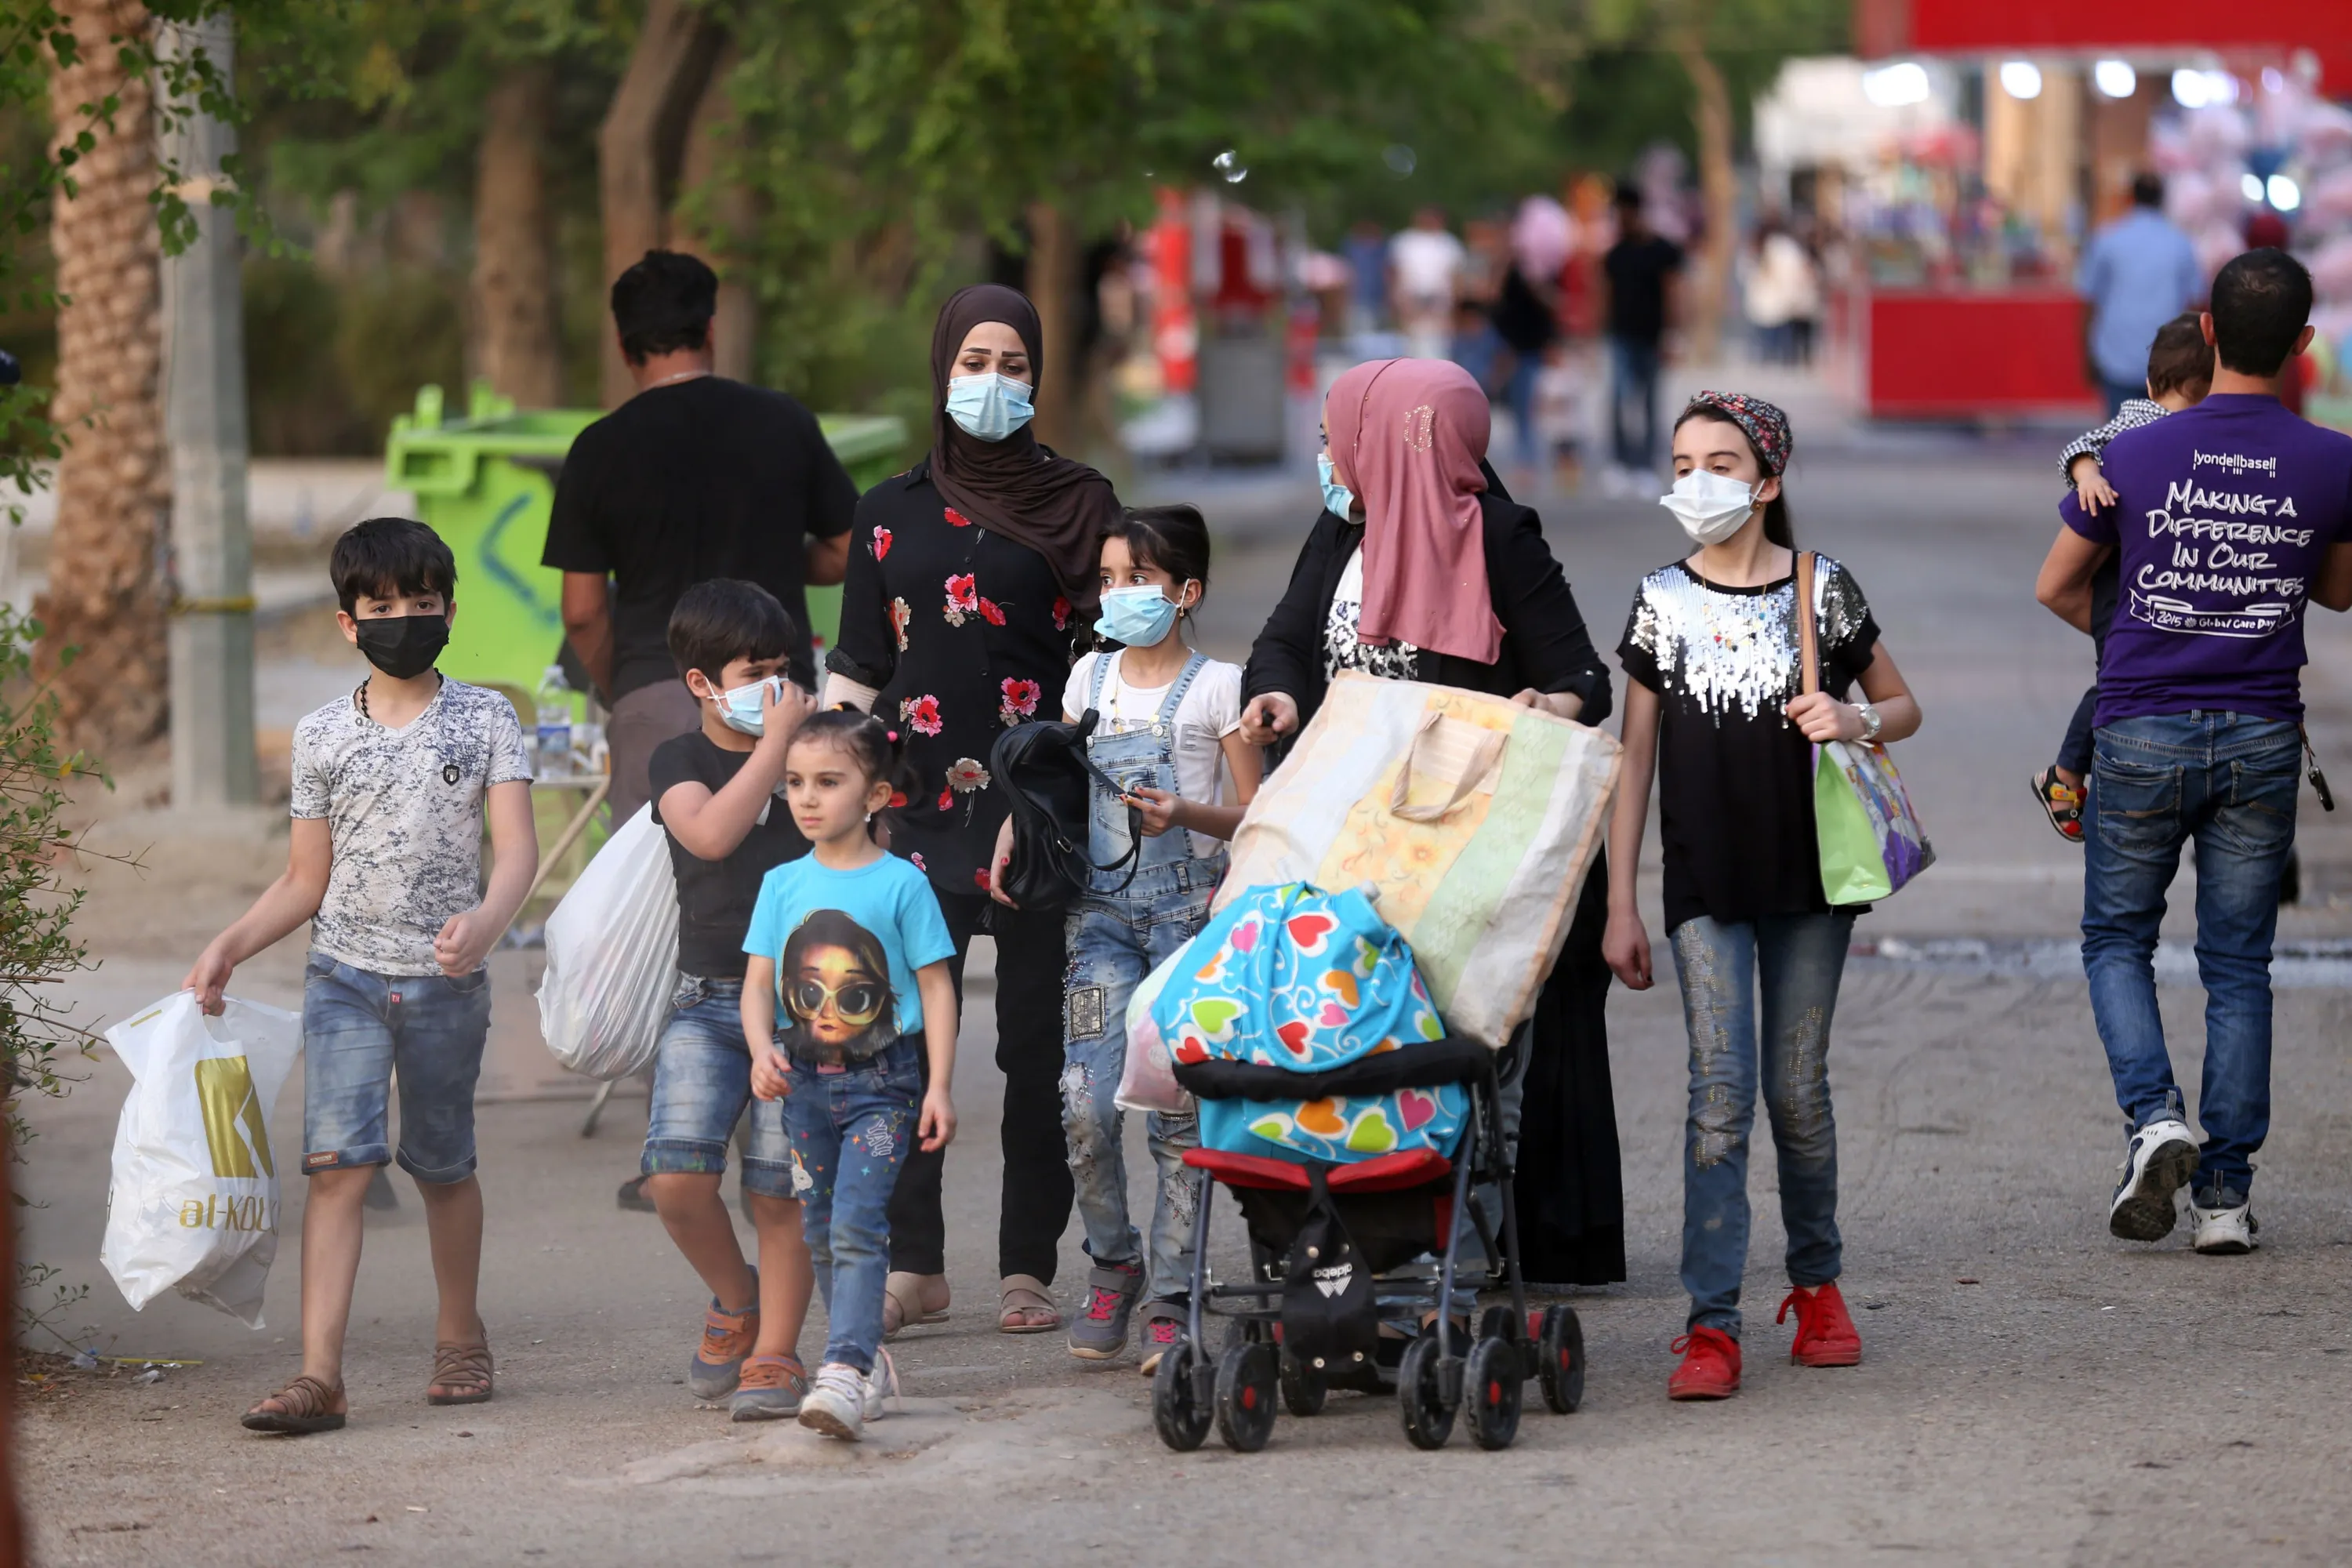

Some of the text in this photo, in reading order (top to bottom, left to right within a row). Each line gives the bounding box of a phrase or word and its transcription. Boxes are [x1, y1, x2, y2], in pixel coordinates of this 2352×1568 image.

[2193, 449, 2276, 477] lyondellbasell
[2146, 510, 2314, 547] DIFFERENCE
[2157, 611, 2183, 627] 2015
[2233, 619, 2256, 630] Care
[2257, 619, 2277, 632] Day
